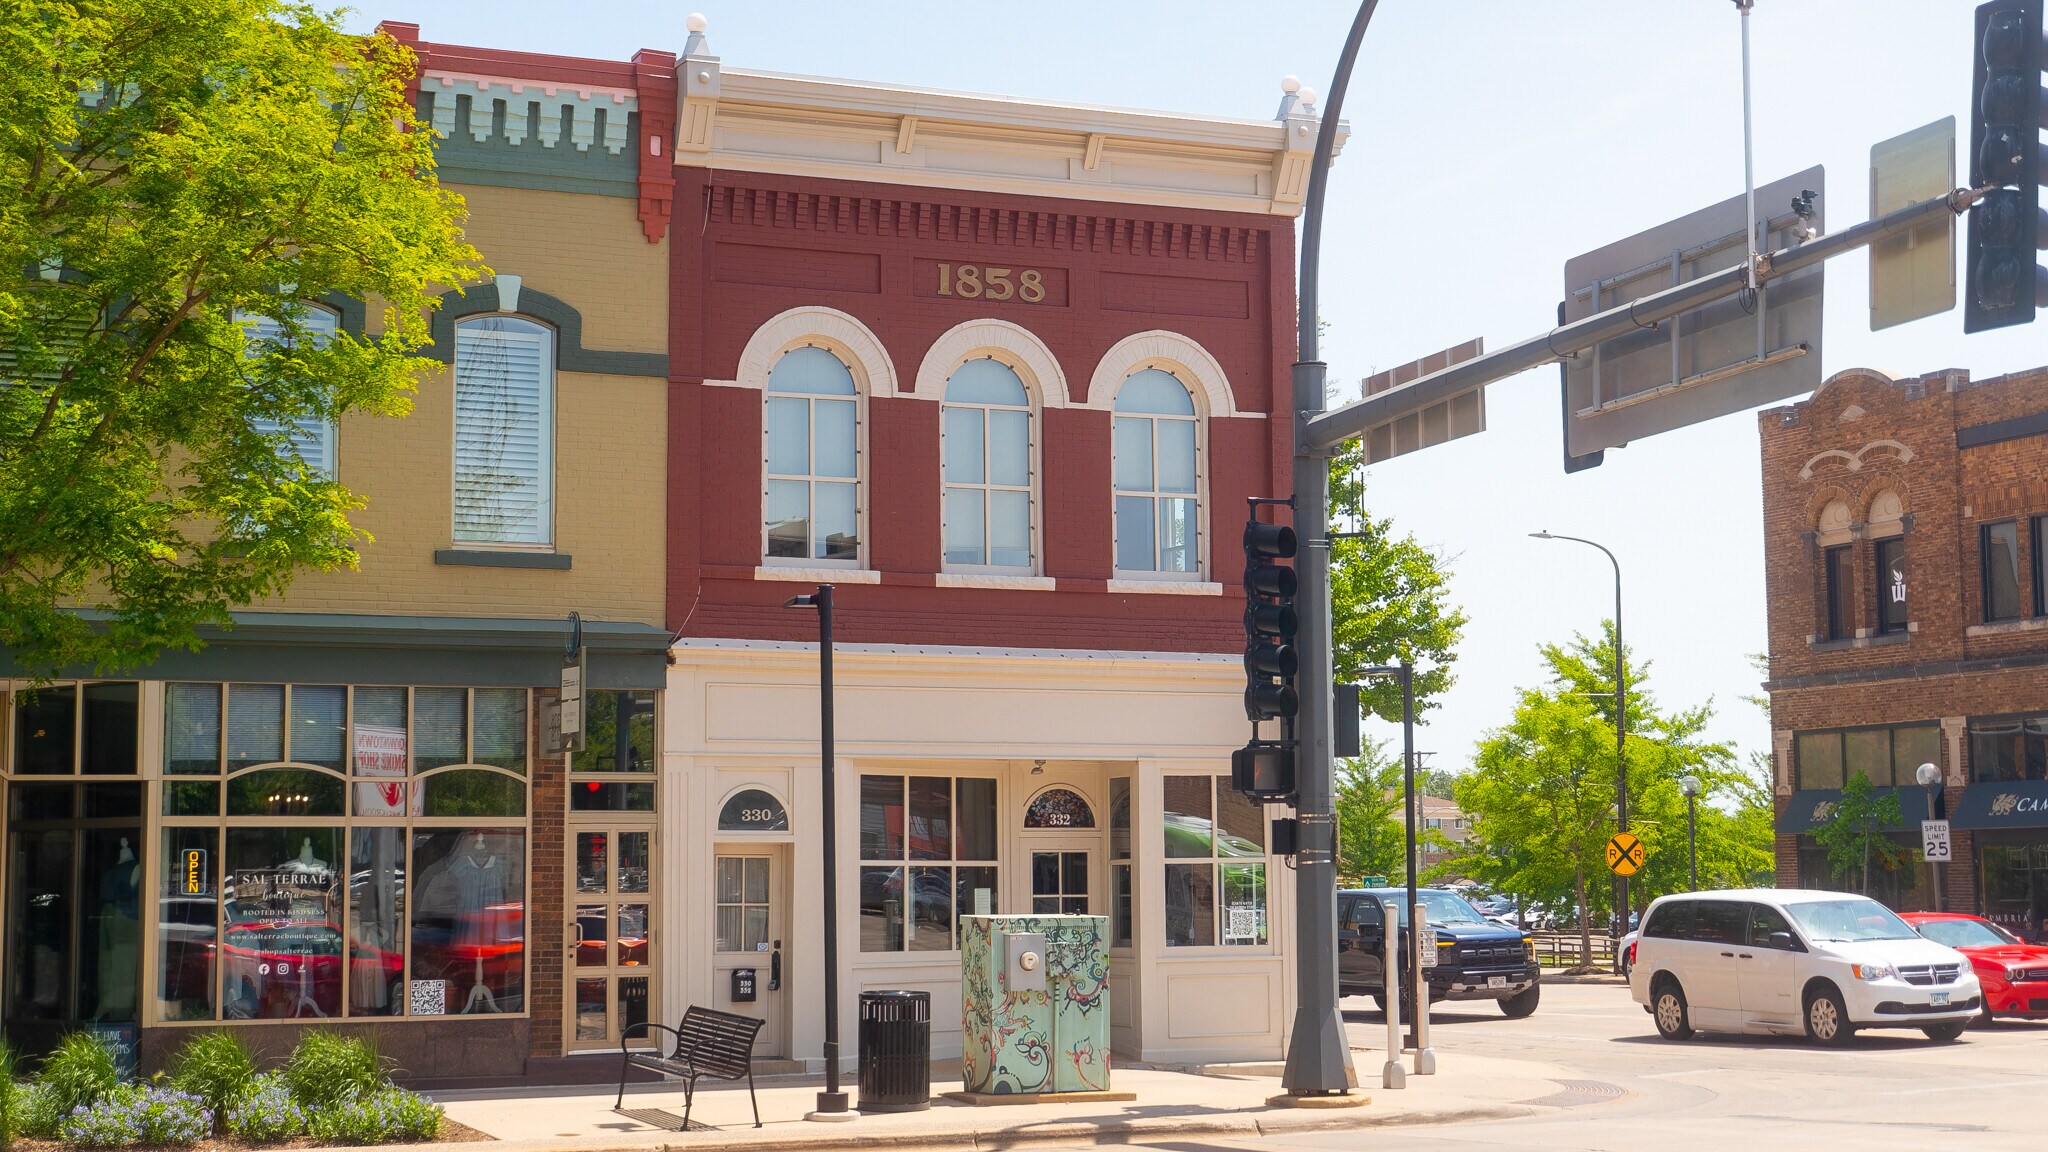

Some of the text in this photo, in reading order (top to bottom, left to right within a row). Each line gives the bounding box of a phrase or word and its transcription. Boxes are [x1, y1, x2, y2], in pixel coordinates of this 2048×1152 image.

[937, 263, 1046, 303] 1858
[741, 809, 771, 822] 330
[1049, 813, 1071, 826] 332
[1926, 841, 1949, 857] 25
[188, 851, 199, 893] OPEN
[242, 874, 327, 885] SAL TERRAE
[261, 888, 306, 904] boutique
[242, 909, 276, 917] ROOTED
[287, 908, 326, 916] KINDNESS
[1980, 912, 2028, 923] CAMBRIA
